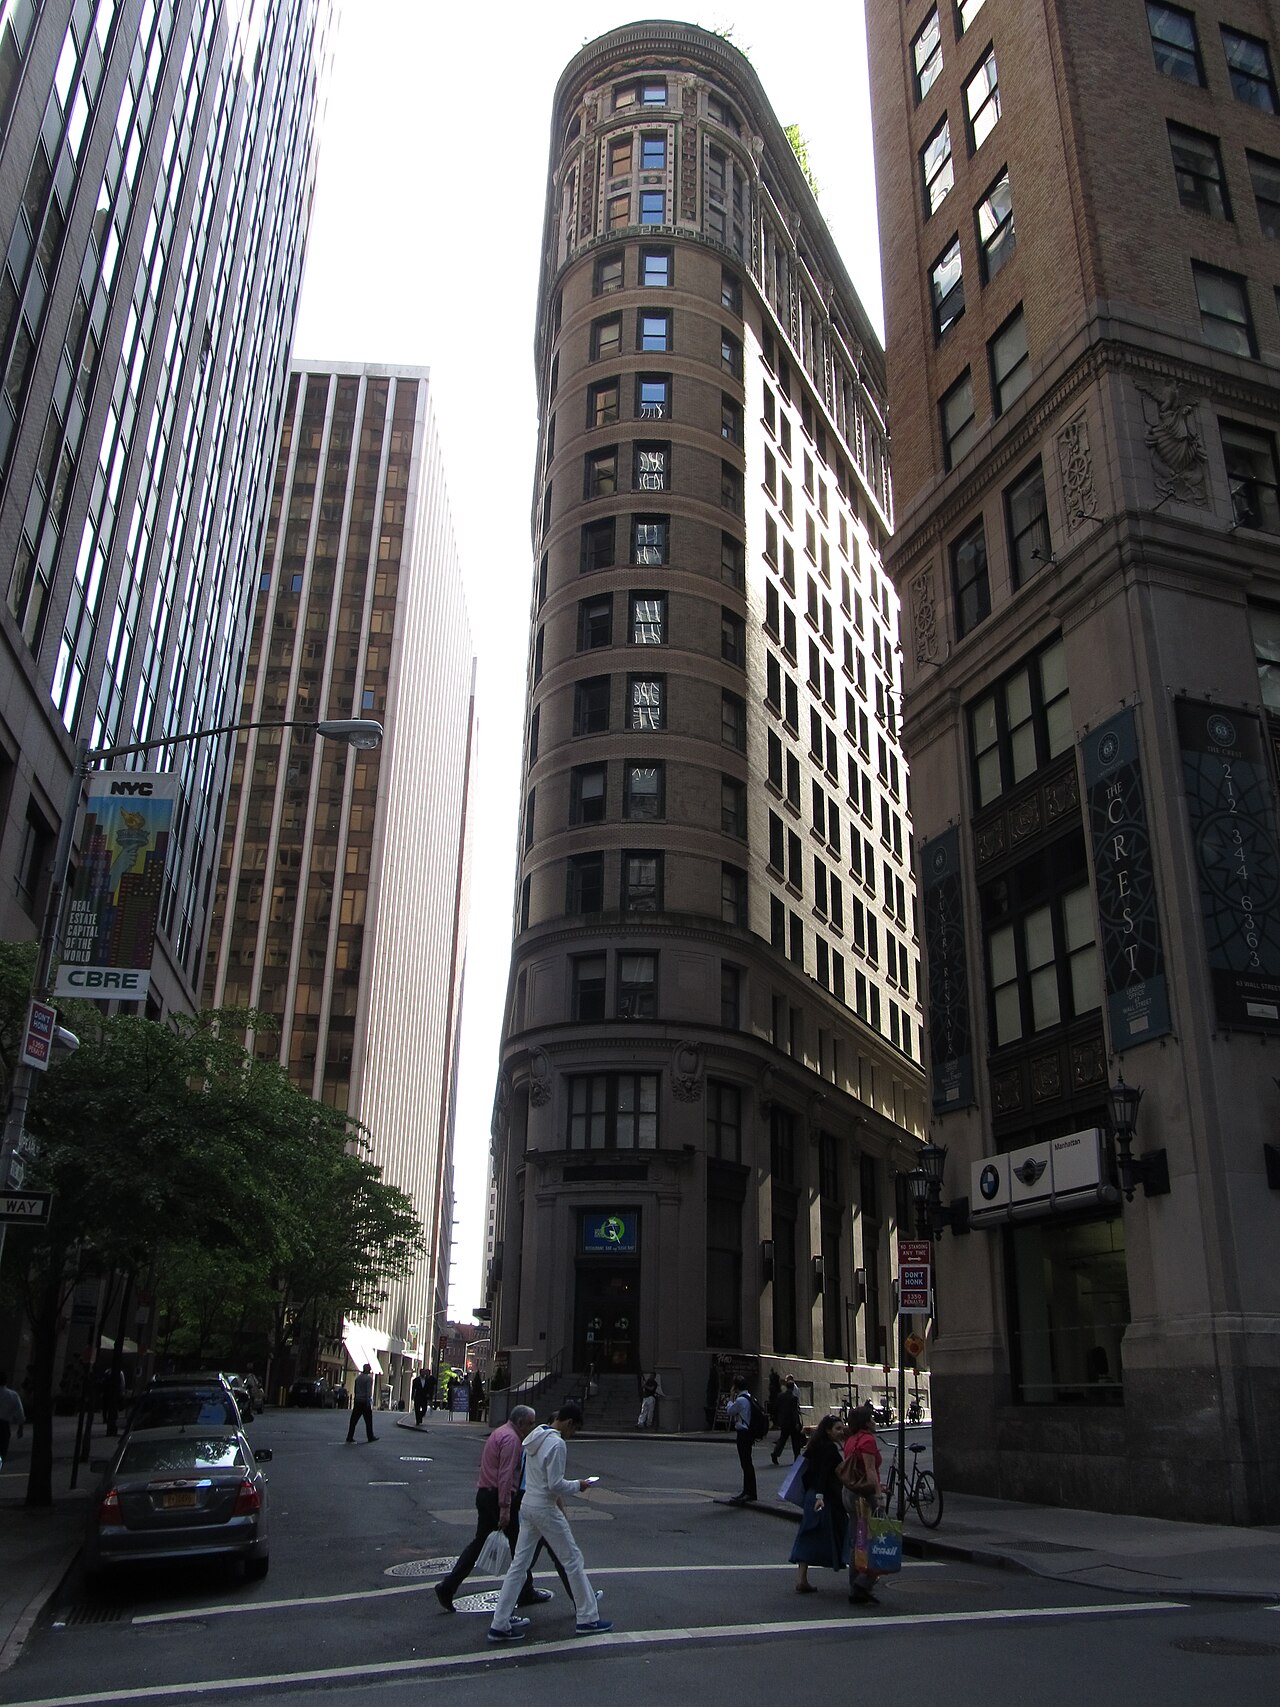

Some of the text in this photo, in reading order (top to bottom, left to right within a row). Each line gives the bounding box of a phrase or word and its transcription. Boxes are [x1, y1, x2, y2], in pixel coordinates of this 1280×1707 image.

[1215, 725, 1228, 736] 63
[110, 782, 153, 797] NYC
[1106, 782, 1123, 799] THE
[1223, 763, 1238, 813] 212
[1231, 829, 1249, 881] 344
[1108, 798, 1138, 972] CREST
[71, 900, 91, 912] REAL
[69, 913, 98, 925] ESTATE
[67, 925, 99, 938] CAPITAL
[1242, 895, 1260, 968] 6363
[64, 937, 93, 950] OF THE
[63, 950, 91, 962] WORLD
[68, 971, 139, 989] CBRE
[1244, 981, 1261, 990] WALL
[1126, 982, 1146, 995] LEASING
[1128, 989, 1145, 1000] OFFICE
[1135, 997, 1152, 1010] STREET
[1054, 1139, 1081, 1151] Manhattan
[6, 1200, 37, 1214] WAY
